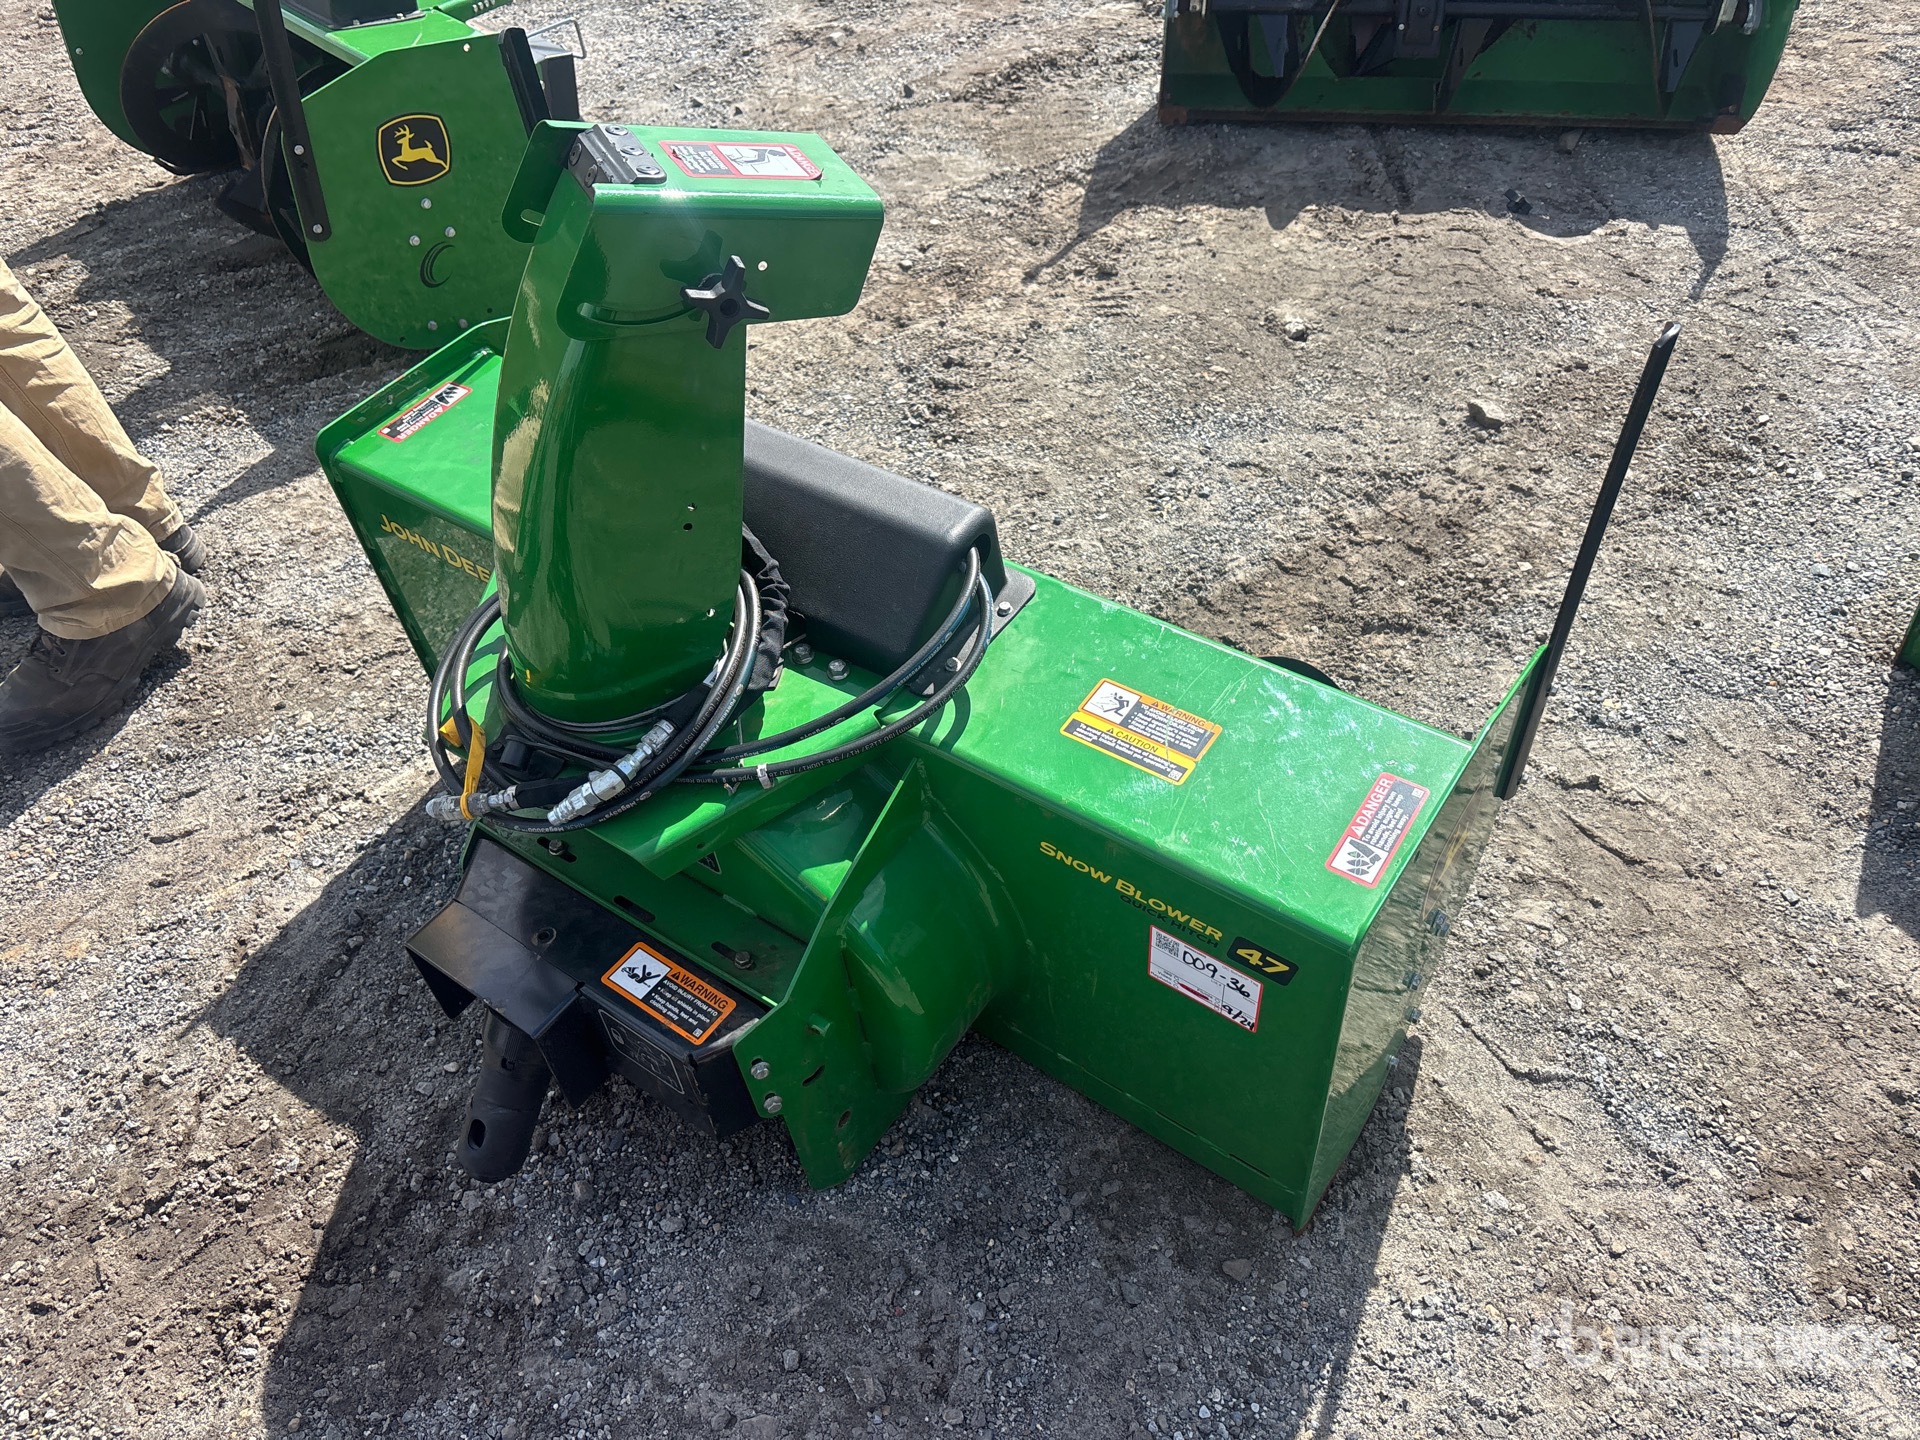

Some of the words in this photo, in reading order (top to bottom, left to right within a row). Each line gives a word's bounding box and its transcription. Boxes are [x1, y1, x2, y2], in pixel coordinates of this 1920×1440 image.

[395, 411, 437, 440] DANGER
[379, 514, 441, 559] JOHN
[441, 544, 491, 584] DEE
[1159, 704, 1206, 726] WARNING
[1115, 730, 1158, 752] CAUTION
[1355, 777, 1392, 826] DANGER
[1361, 833, 1370, 842] To
[1366, 818, 1379, 834] avoid
[1375, 803, 1390, 819] injury
[1384, 790, 1396, 803] from
[1392, 807, 1403, 818] and
[1369, 823, 1386, 845] rotating
[1391, 793, 1404, 807] keep
[1382, 828, 1400, 851] clothing
[1039, 841, 1112, 884] SNOW
[1115, 879, 1223, 942] BLOWER
[1120, 895, 1166, 923] QUICK
[1170, 919, 1219, 948] HITCH
[1235, 948, 1290, 973] 47
[662, 979, 678, 990] AVOID
[676, 988, 694, 1001] INJURY
[692, 998, 708, 1010] FROM
[706, 1007, 718, 1016] PTO
[678, 974, 729, 1009] WARNING
[648, 999, 668, 1013] clothing
[665, 1010, 678, 1020] away
[653, 994, 666, 1004] Keep
[679, 1011, 689, 1019] feet
[687, 1017, 698, 1025] and
[676, 999, 693, 1011] shields
[696, 1012, 710, 1023] place
